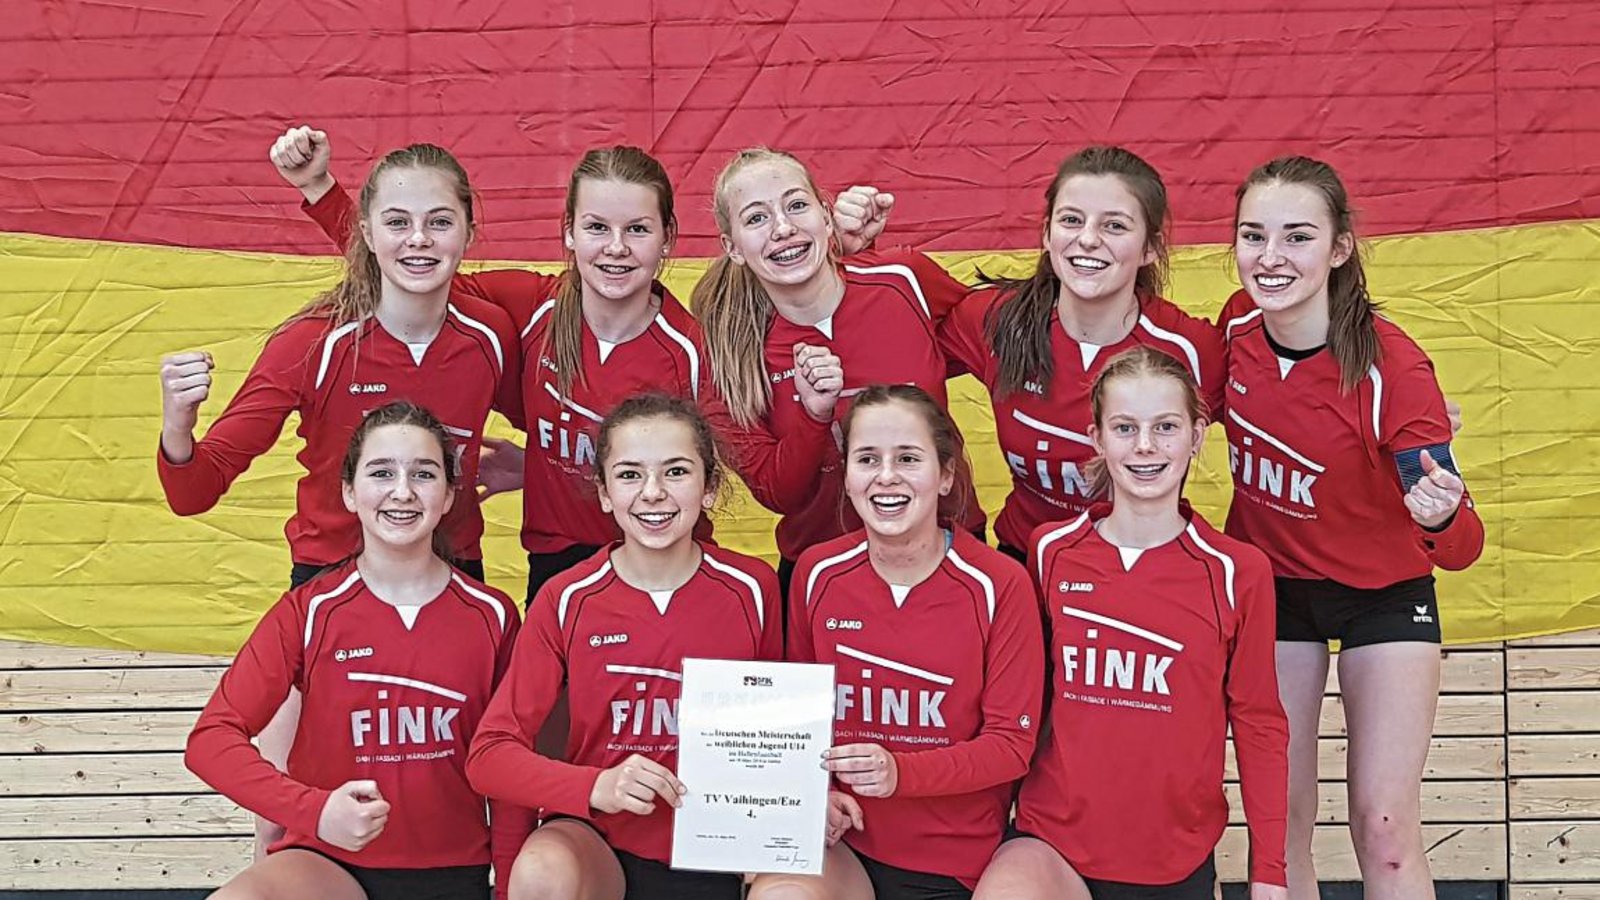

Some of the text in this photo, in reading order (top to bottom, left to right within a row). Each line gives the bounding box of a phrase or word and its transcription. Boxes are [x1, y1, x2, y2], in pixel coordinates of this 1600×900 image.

[362, 383, 387, 393] JAKO
[1070, 582, 1094, 592] JAKO
[838, 620, 862, 630] JAKO
[603, 634, 629, 644] JAKO
[347, 647, 374, 659] JAKO
[758, 730, 812, 740] Meisterschaft
[715, 740, 757, 749] weiblichen
[758, 741, 787, 751] Jugend
[789, 742, 805, 750] U14
[704, 793, 801, 807] TV Vaihingen/Enz
[747, 809, 757, 819] 4.
